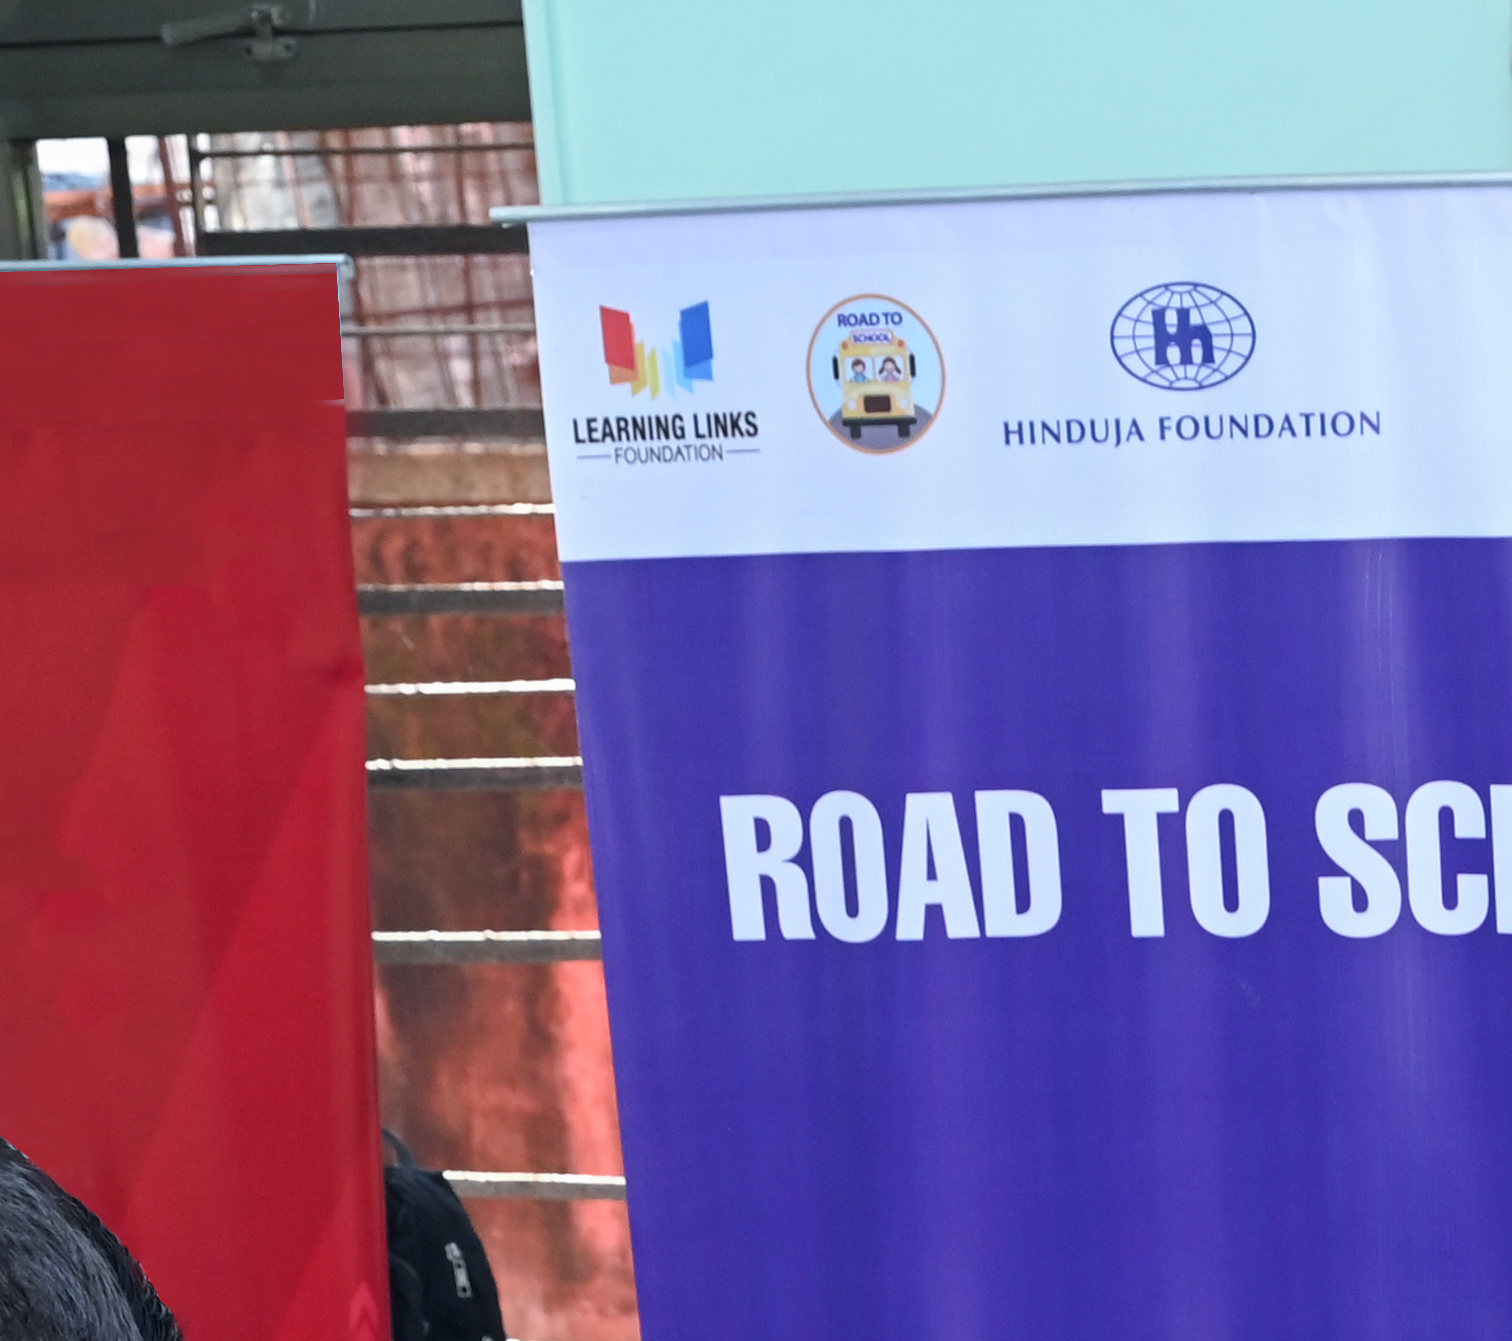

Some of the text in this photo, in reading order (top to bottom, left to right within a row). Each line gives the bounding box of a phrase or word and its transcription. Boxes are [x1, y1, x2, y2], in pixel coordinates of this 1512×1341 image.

[837, 311, 903, 329] ROAD TO
[852, 332, 892, 343] SCHOOL
[572, 410, 759, 444] LEARNING LINKS
[1002, 410, 1382, 448] HINDUJA FOUNDATION
[613, 444, 724, 466] FOUNDATION
[718, 787, 1065, 945] ROAD
[1100, 781, 1272, 941] TO
